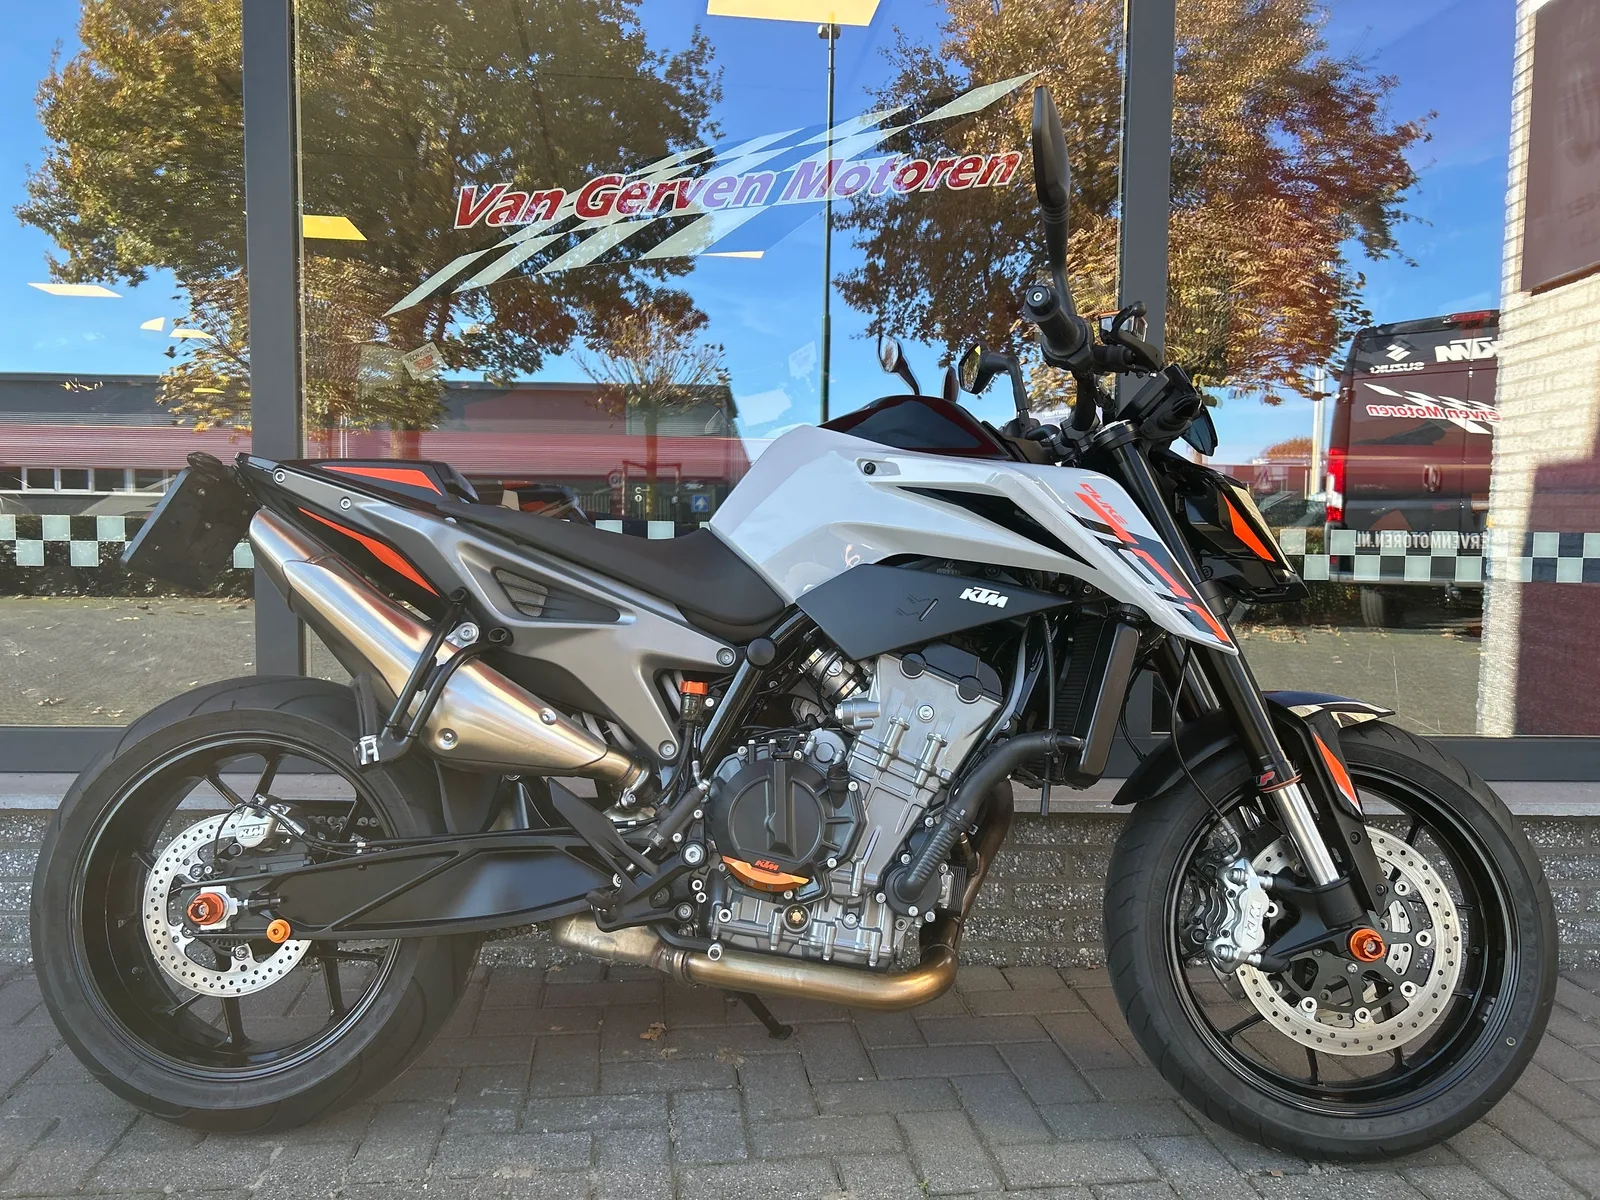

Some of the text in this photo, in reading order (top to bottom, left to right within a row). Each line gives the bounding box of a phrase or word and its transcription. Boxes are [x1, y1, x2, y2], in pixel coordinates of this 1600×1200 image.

[453, 151, 1023, 230] Van Gerven Motoren
[1079, 482, 1129, 525] DUKE
[959, 586, 1009, 609] KTM
[754, 859, 780, 871] KTM
